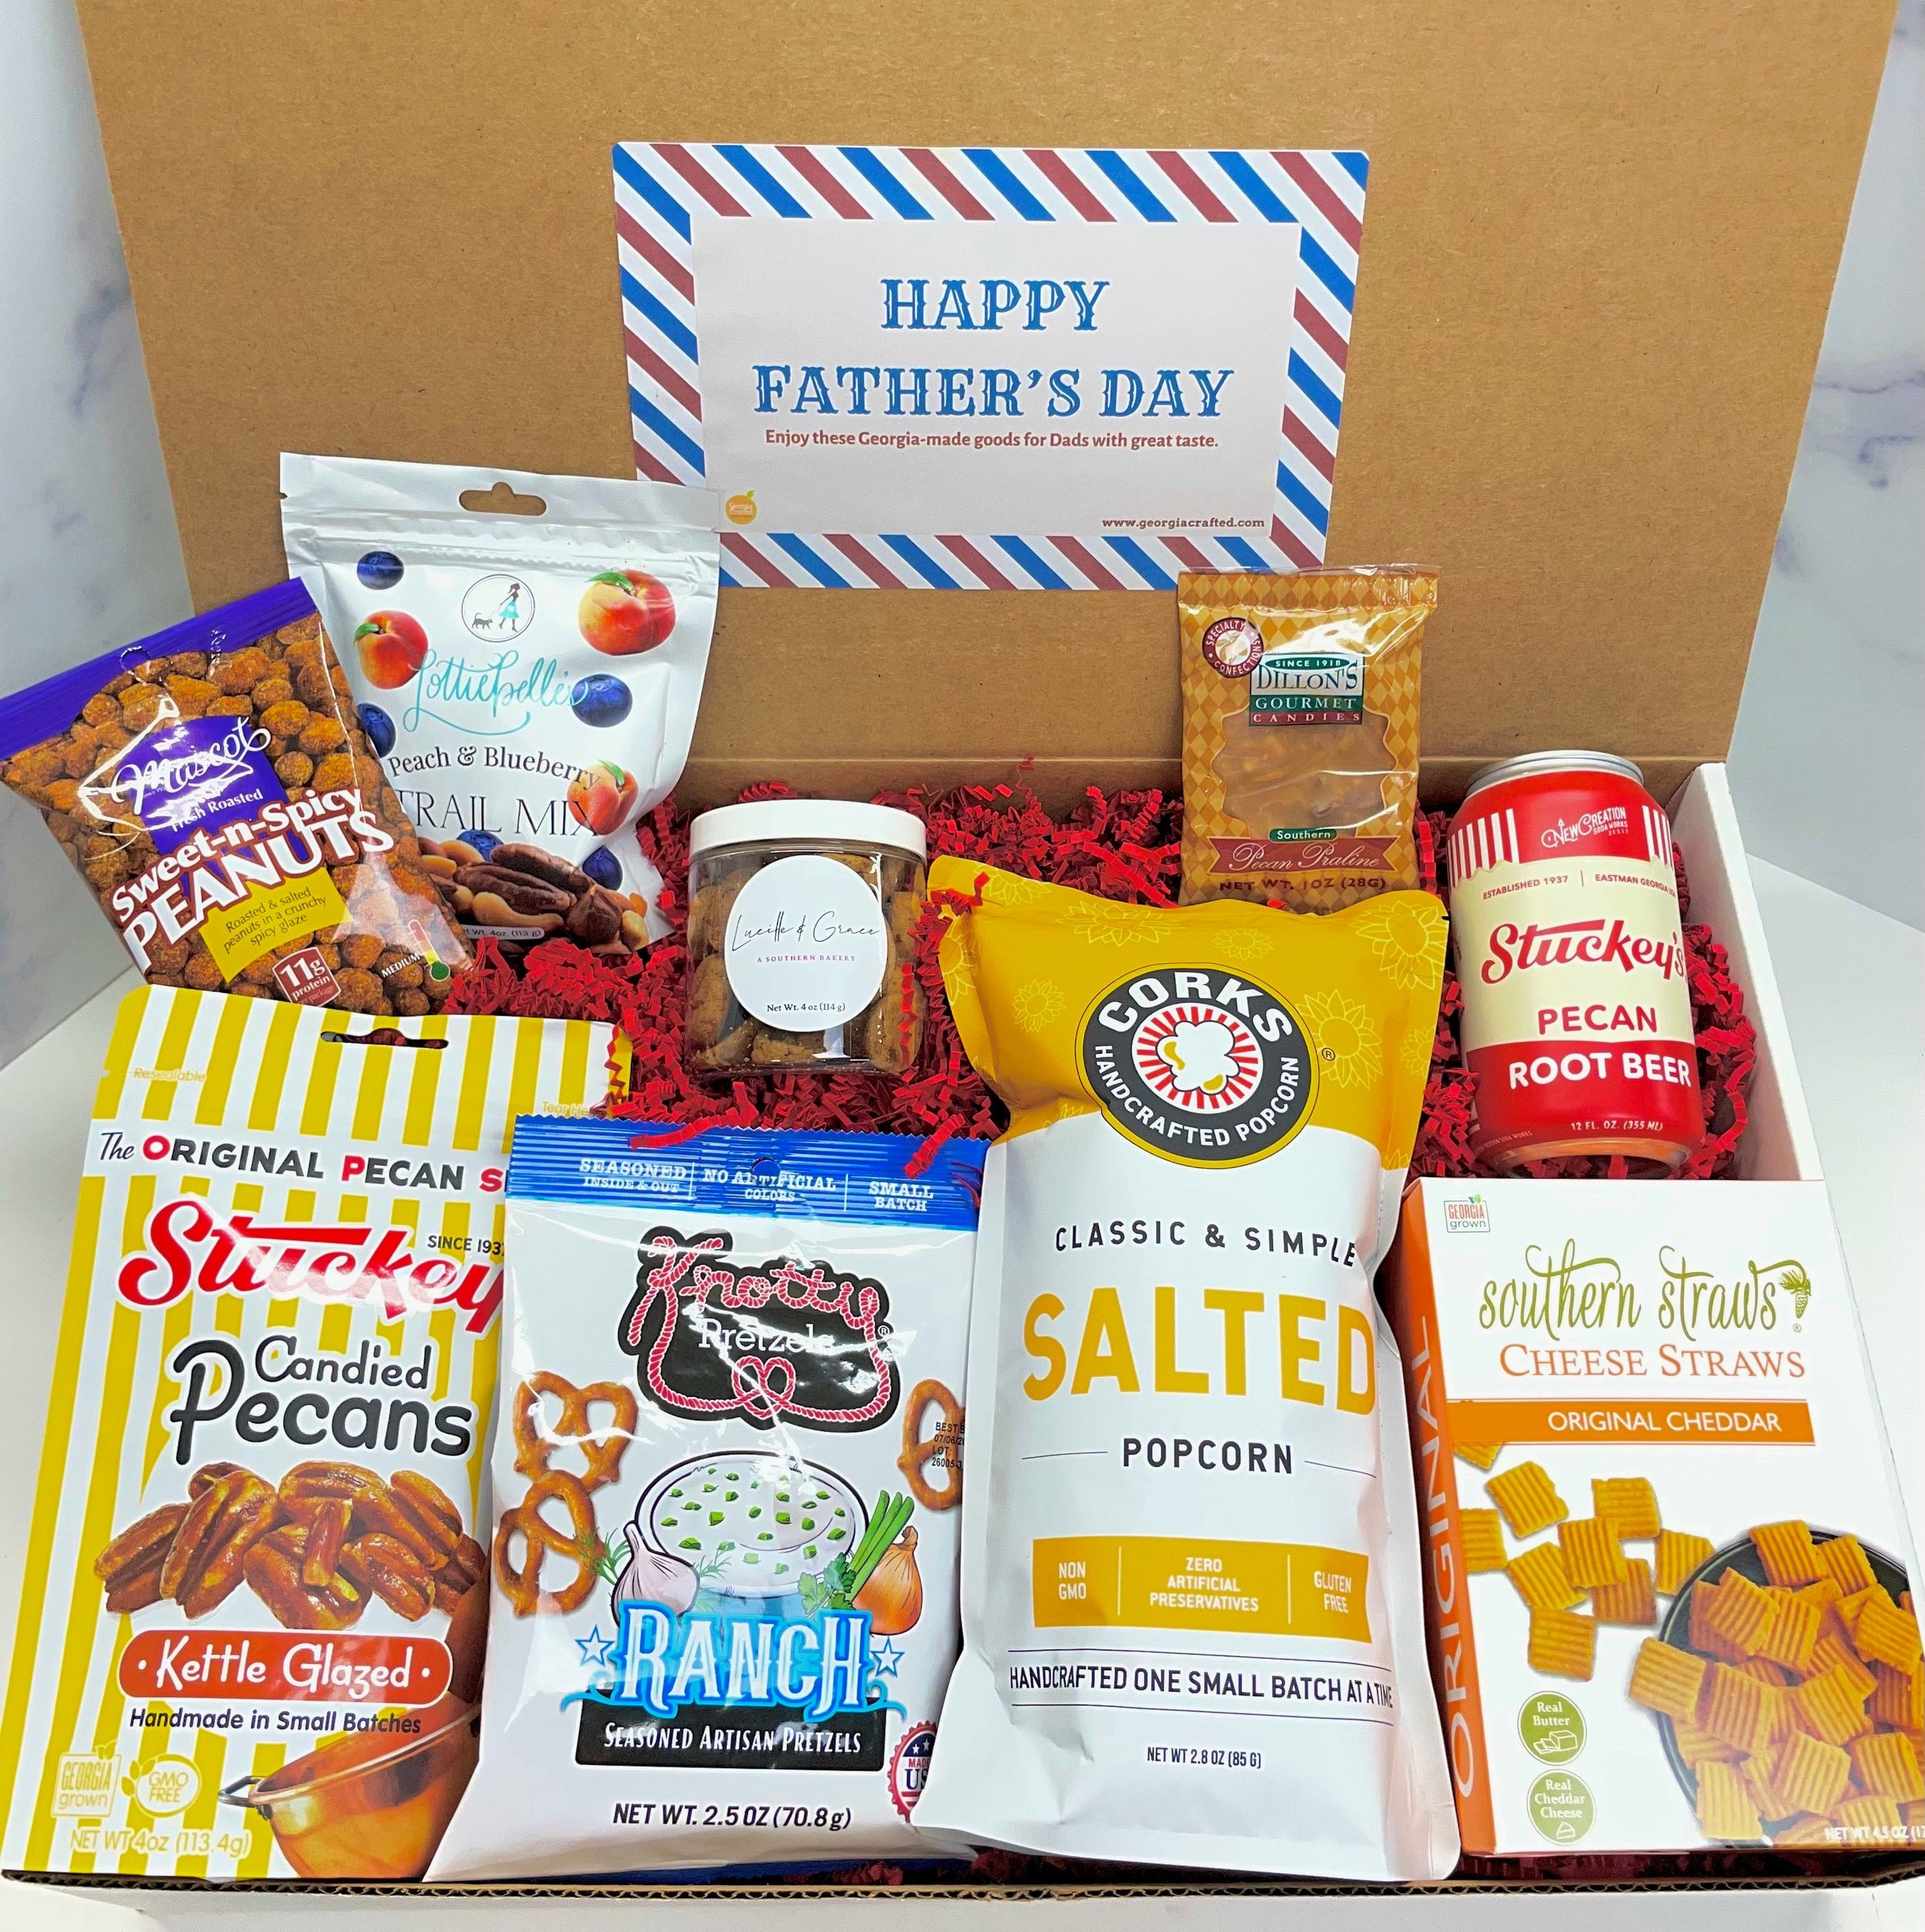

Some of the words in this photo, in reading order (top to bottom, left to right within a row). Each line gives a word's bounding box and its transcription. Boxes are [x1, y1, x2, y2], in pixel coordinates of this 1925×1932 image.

[880, 278, 1110, 331] HAPPY
[752, 364, 1080, 417] FATHER'S
[1099, 369, 1234, 417] DAY
[765, 430, 809, 447] Enjoy
[812, 430, 855, 445] these
[859, 431, 970, 449] Georgia-made
[974, 432, 1020, 450] goods
[1024, 432, 1046, 447] for
[1050, 433, 1089, 447] Dads
[1093, 433, 1127, 447] with
[1131, 434, 1173, 450] great
[1176, 434, 1218, 447] taste.
[1102, 517, 1264, 530] www.georgiacrafted.com
[1206, 621, 1246, 646] SPECIALTY
[1214, 640, 1261, 675] CONFECTIONS
[1275, 659, 1310, 668] SINCE
[1256, 660, 1358, 690] DILLON'S
[1255, 698, 1357, 710] GOURMET
[1254, 714, 1360, 722] CANDIES
[387, 747, 450, 778] Peach
[457, 746, 477, 766] &
[484, 747, 602, 790] Blueberry
[208, 789, 263, 813] Roasted
[514, 799, 600, 837] MIX
[1277, 830, 1331, 839] Southern
[112, 788, 361, 923] Sweet-n-Spicy
[1229, 842, 1292, 870] Pecan
[1297, 842, 1380, 869] Praline
[122, 811, 394, 976] PEANUTS
[1220, 882, 1255, 892] NET
[1261, 879, 1294, 890] WT.
[1341, 877, 1386, 889] (28G)
[1483, 879, 1541, 900] ESTABLISHED
[1544, 875, 1568, 886] 1937
[1595, 874, 1639, 884] EASTMAN
[1641, 878, 1668, 892] GEORGIA
[226, 902, 266, 933] Roasted
[268, 900, 277, 909] &
[280, 886, 312, 905] salted
[223, 920, 261, 954] peanuts
[262, 915, 273, 925] in
[285, 896, 327, 916] crunchy
[250, 926, 276, 946] spicy
[279, 914, 308, 933] glaze
[732, 911, 794, 952] Lucille
[813, 910, 880, 943] Grace
[1481, 919, 1686, 984] Stuckey's
[280, 957, 326, 987] 11g
[381, 951, 420, 978] MEDIUM
[292, 976, 330, 1001] protein
[783, 1003, 800, 1012] Wt.
[1098, 971, 1293, 1042] CORKS
[1538, 1004, 1657, 1036] PECAN
[134, 1067, 206, 1082] Resealable
[1509, 1053, 1612, 1090] ROOT
[1622, 1052, 1692, 1088] BEER
[542, 1101, 568, 1114] Tear
[1095, 1045, 1230, 1147] HANDCRAFTED
[1236, 1056, 1299, 1141] POPCORN
[1571, 1121, 1582, 1131] 12
[1623, 1120, 1645, 1130] (355
[100, 1131, 134, 1161] The
[142, 1135, 323, 1179] ORIGINAL
[341, 1154, 464, 1191] PECAN
[579, 1158, 687, 1180] SEASONED
[582, 1176, 634, 1190] INSIDE
[651, 1182, 679, 1193] OUT
[702, 1168, 728, 1184] NO
[745, 1189, 795, 1203] COLORS
[869, 1181, 933, 1199] SMALL
[874, 1197, 927, 1211] BATCH
[1448, 1204, 1485, 1219] GEORGIA
[1450, 1220, 1486, 1230] grown
[427, 1235, 472, 1251] SINCE
[1055, 1220, 1186, 1251] CLASSIC
[1204, 1224, 1226, 1247] &
[1244, 1227, 1357, 1267] SIMPLE
[628, 1236, 880, 1346] Knotty
[1479, 1237, 1642, 1341] southern
[1658, 1244, 1803, 1341] straws
[256, 1335, 432, 1388] Candied
[1023, 1285, 1376, 1416] SALTED
[1499, 1343, 1648, 1378] CHEESE
[1659, 1344, 1806, 1378] STRAWS
[170, 1340, 472, 1465] Pecans
[936, 1422, 958, 1432] BEST
[1548, 1411, 1661, 1431] ORIGINAL
[1666, 1412, 1782, 1432] CHEDDAR
[932, 1445, 952, 1455] LOT:
[1123, 1437, 1292, 1474] POPCORN
[1185, 1556, 1223, 1572] ZERO
[1411, 1316, 1474, 1798] ORIGINAL
[1059, 1562, 1086, 1579] NON
[1314, 1570, 1351, 1595] GLUTEN
[1058, 1583, 1086, 1600] GMO
[1167, 1575, 1241, 1592] ARTIFICIAL
[1150, 1592, 1260, 1612] PRESERVATIVES
[1324, 1595, 1349, 1614] FREE
[156, 1635, 266, 1691] Kettle
[283, 1642, 413, 1699] Glazed
[620, 1608, 862, 1716] RANCH
[1009, 1666, 1127, 1690] HANDCRAFTED
[1134, 1668, 1181, 1694] ONE
[1188, 1670, 1264, 1698] SMALL
[1271, 1676, 1342, 1703] BATCH
[1347, 1679, 1362, 1703] AT
[1374, 1683, 1394, 1709] TIME
[1537, 1701, 1563, 1713] Real
[129, 1707, 243, 1729] Handmade
[251, 1710, 270, 1730] in
[277, 1711, 336, 1731] Small
[343, 1713, 421, 1734] Batches
[1532, 1715, 1570, 1726] Butter
[604, 1722, 693, 1750] SEASONED
[699, 1725, 774, 1752] ARTISAN
[782, 1727, 861, 1753] PRETZELS
[1147, 1746, 1167, 1763] NET
[1170, 1747, 1188, 1763] WT
[1190, 1749, 1209, 1764] 2.8
[1210, 1750, 1224, 1766] OZ
[1227, 1750, 1247, 1767] (85
[1249, 1751, 1262, 1769] G)
[61, 1761, 113, 1791] GEORGIA
[148, 1772, 189, 1788] GMO
[1545, 1779, 1572, 1790] Real
[59, 1793, 108, 1810] grown
[149, 1789, 180, 1803] FREE
[1534, 1792, 1585, 1804] Cheddar
[613, 1803, 656, 1826] NET
[661, 1805, 697, 1826] WT.
[705, 1805, 739, 1827] 2.5
[743, 1805, 770, 1827] OZ
[773, 1806, 826, 1829] (70.8
[829, 1807, 852, 1830] g)
[1540, 1806, 1583, 1818] Cheese
[71, 1830, 100, 1849] NET
[104, 1831, 130, 1850] WT
[132, 1833, 169, 1852] 4oz
[176, 1831, 249, 1857] (113.4g)
[1824, 1827, 1848, 1840] NET
[1850, 1826, 1870, 1840] WT
